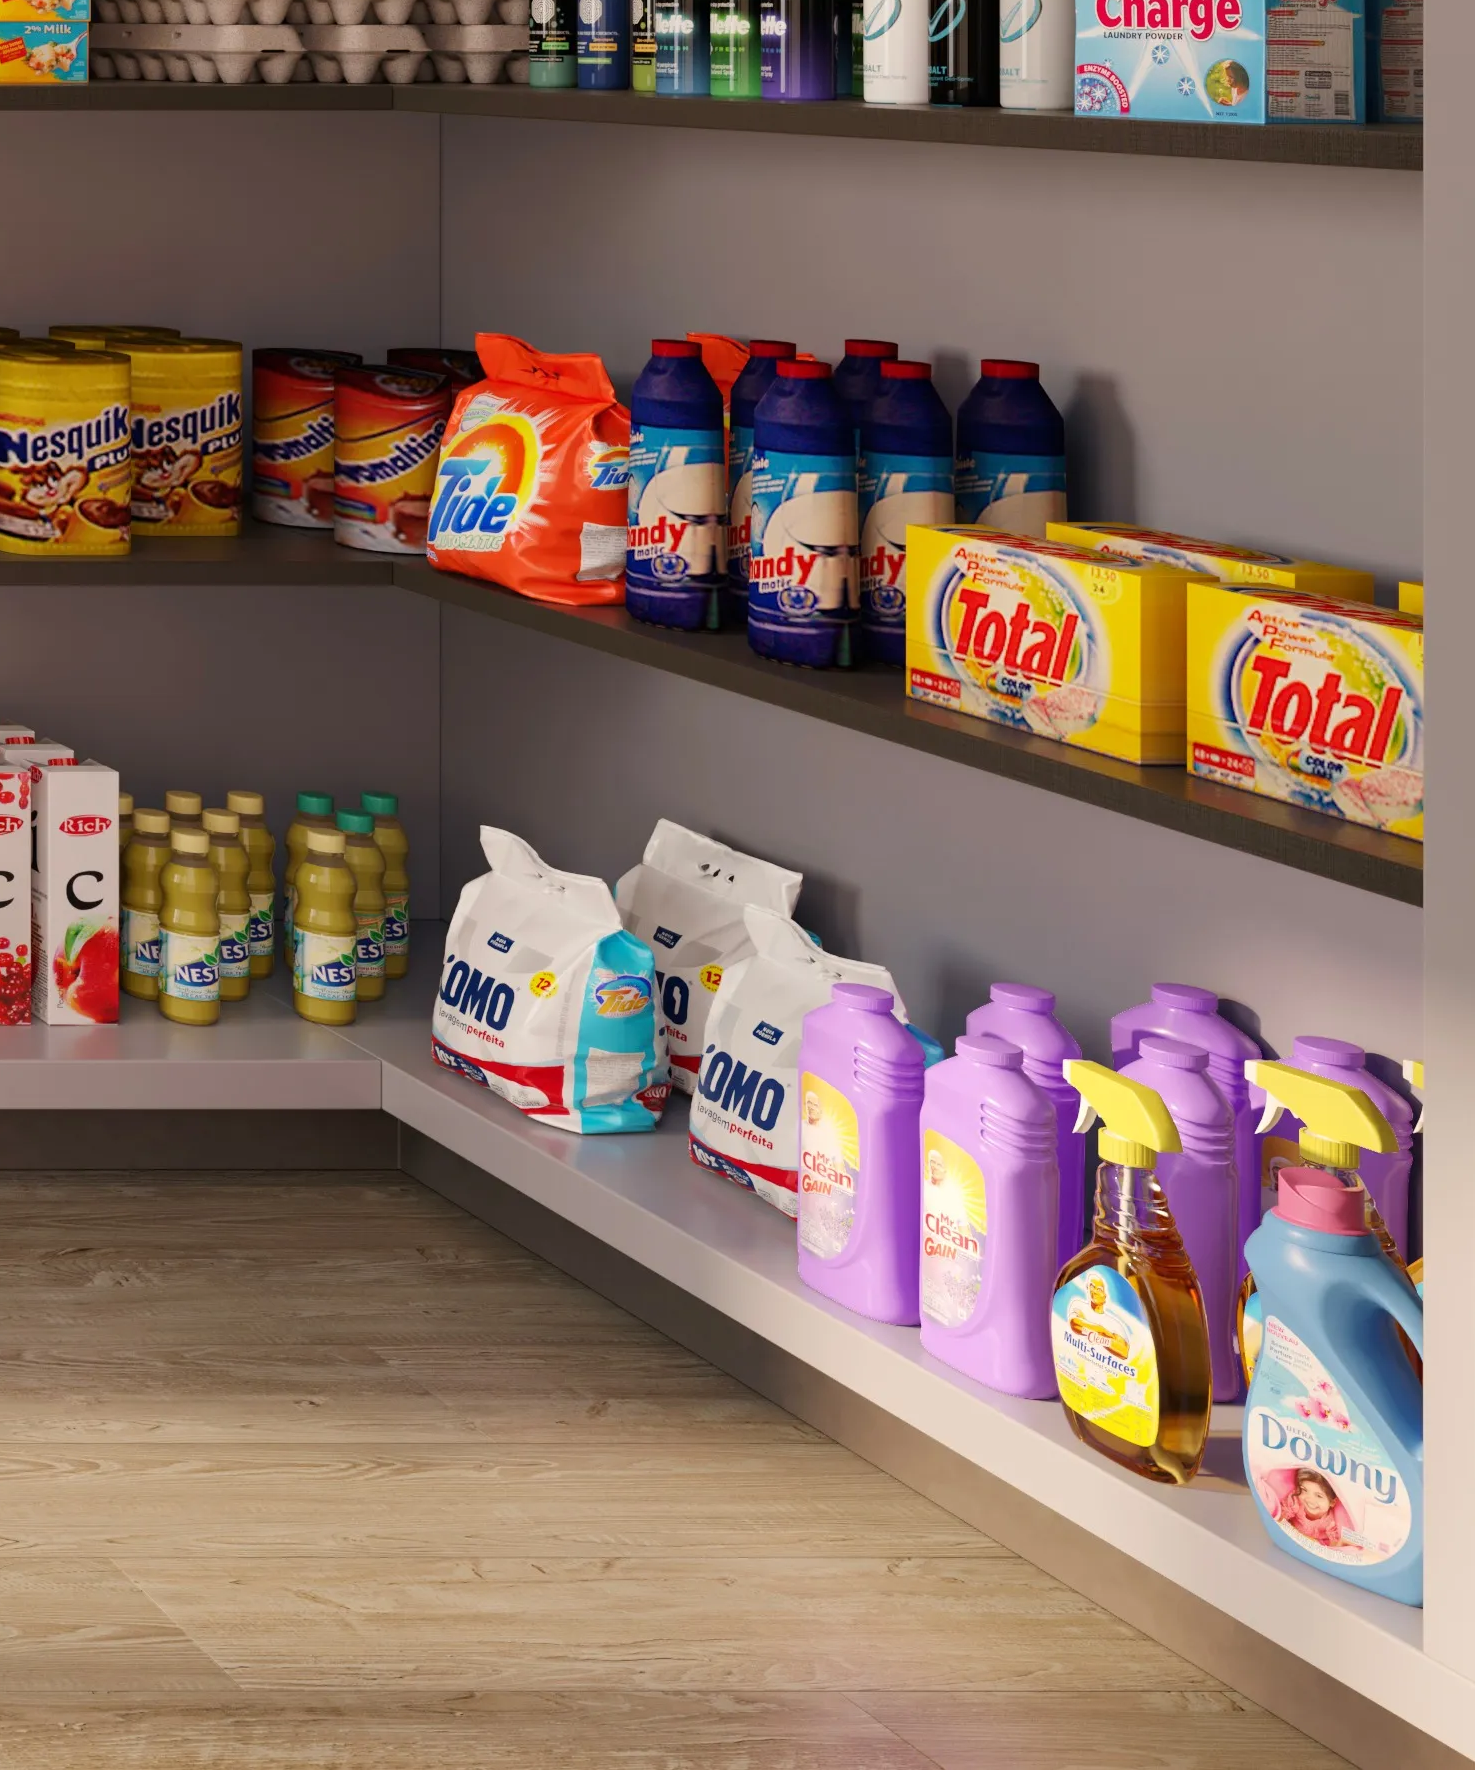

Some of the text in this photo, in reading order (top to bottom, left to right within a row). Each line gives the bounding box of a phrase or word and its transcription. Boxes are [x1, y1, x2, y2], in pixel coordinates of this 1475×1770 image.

[1103, 31, 1183, 41] LAUNDRY POWDER
[1083, 65, 1129, 108] ENZYME BOOSTED
[427, 457, 516, 542] Tide
[749, 548, 822, 585] handy
[955, 547, 997, 563] Active
[967, 560, 1010, 577] Power
[972, 572, 1024, 592] Formula
[954, 588, 1079, 687] Total
[1248, 655, 1403, 769] Total
[444, 961, 515, 1031] OMO
[535, 977, 551, 992] 12
[595, 988, 651, 1015] Tide
[802, 1151, 853, 1189] Clean
[816, 1150, 832, 1164] Mr.
[802, 1173, 832, 1197] GAIN
[925, 1209, 978, 1255] Clean
[1063, 1330, 1136, 1379] Multi-Surfaces
[1285, 1424, 1314, 1441] ULTRA
[1258, 1412, 1397, 1505] Downy
